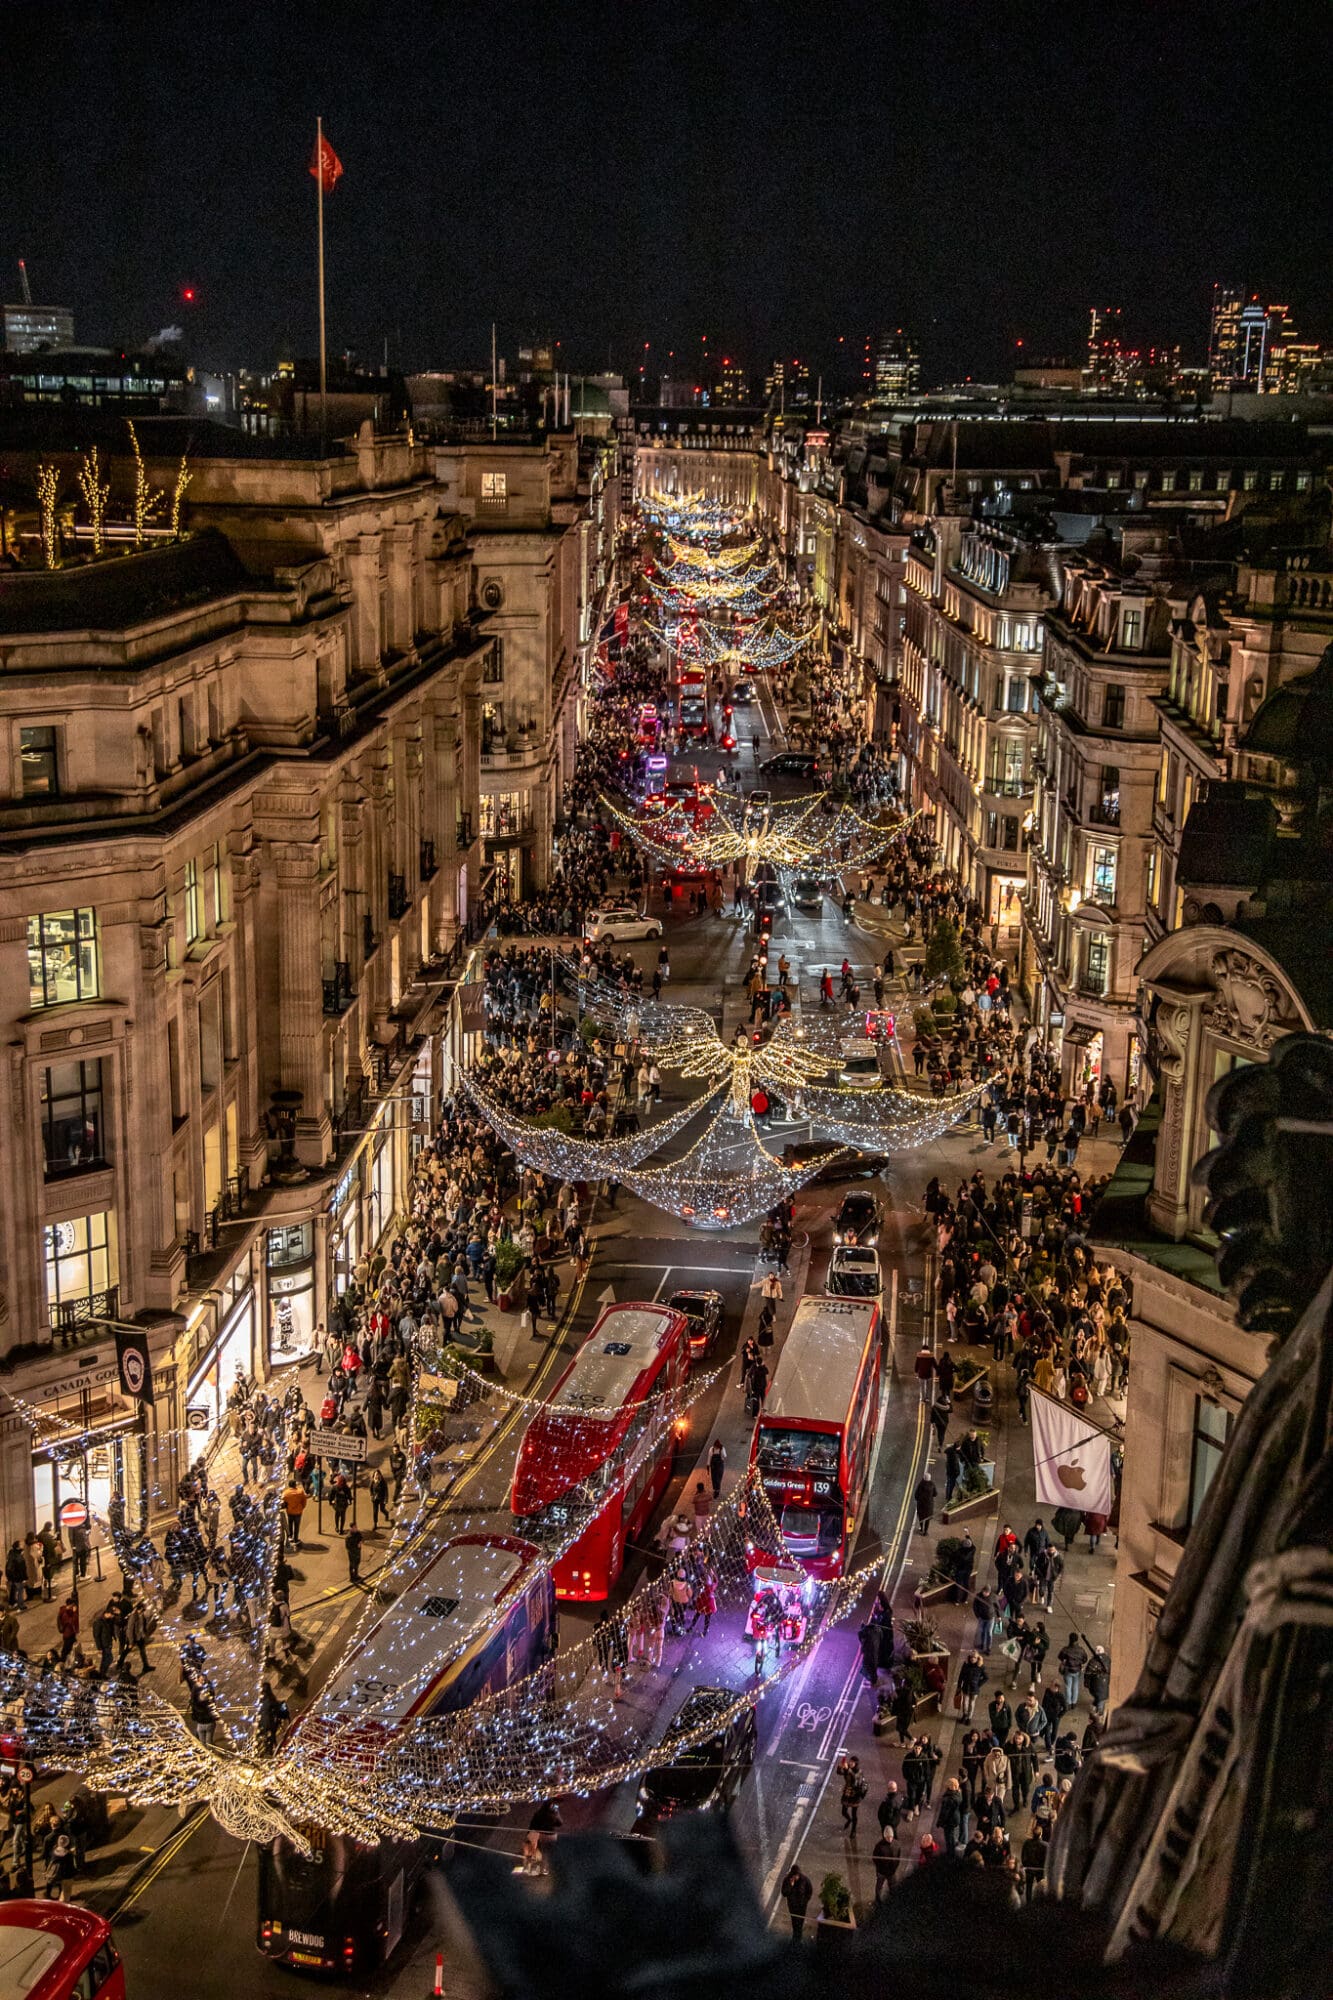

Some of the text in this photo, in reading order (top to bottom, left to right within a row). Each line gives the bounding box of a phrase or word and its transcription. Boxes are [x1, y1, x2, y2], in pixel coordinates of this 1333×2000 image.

[43, 1376, 92, 1397] CANADA
[312, 1438, 336, 1446] Trafalgar
[763, 1479, 830, 1493] Golders Green 139
[553, 1506, 568, 1520] 55
[288, 1928, 325, 1948] BREWDOG
